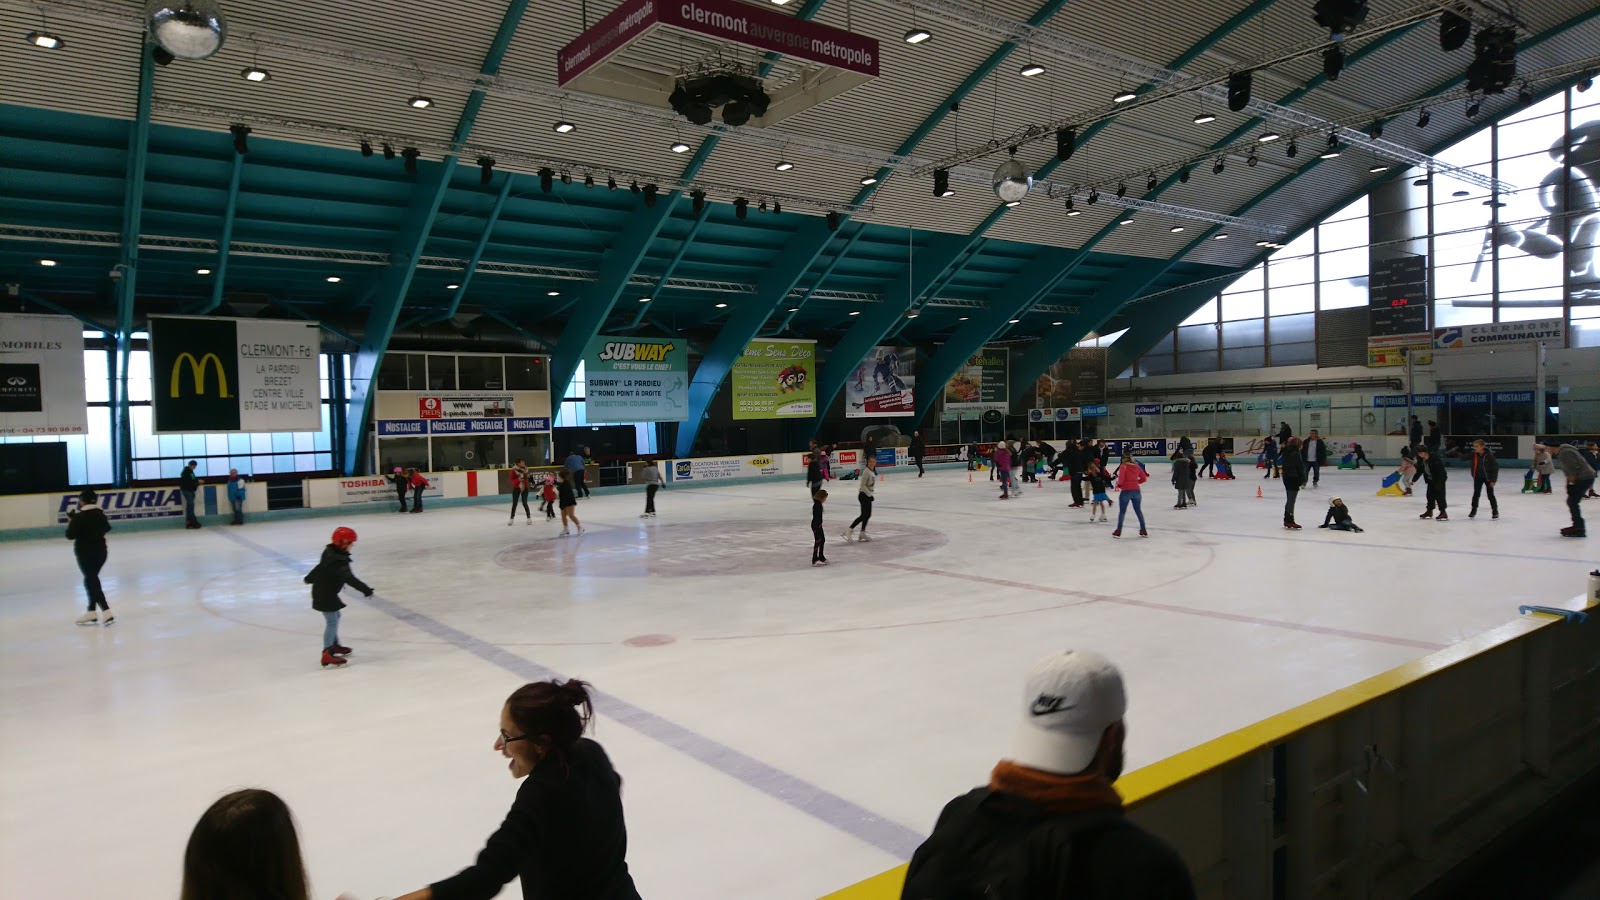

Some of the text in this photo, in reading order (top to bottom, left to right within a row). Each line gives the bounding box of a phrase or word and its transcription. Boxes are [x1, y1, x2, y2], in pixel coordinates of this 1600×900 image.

[564, 43, 591, 72] clermont
[618, 1, 653, 34] métropole
[681, 3, 872, 66] clermont auvergne métropole
[1471, 321, 1561, 334] CLERMONT
[1471, 329, 1561, 342] COMMUNAUTÉ
[598, 341, 675, 363] SUBWAY
[765, 344, 788, 357] Sens
[256, 364, 300, 374] LA PARDIEU
[264, 376, 293, 386] BREZET
[253, 388, 304, 398] CENTRE VILLE
[1496, 394, 1532, 402] NOSTALGIE
[427, 399, 434, 409] 4
[1376, 396, 1408, 406] NOSTALGIE
[1414, 395, 1446, 404] NOSTALGIE
[1454, 394, 1488, 404] NOSTALGIE
[244, 401, 268, 410] STADE
[385, 422, 422, 433] NOSTALGIE
[432, 421, 466, 431] NOSTALGIE
[471, 420, 504, 430] NOSTALGIE
[513, 420, 544, 429] NOSTALGIE
[1122, 441, 1159, 449] FLEURY
[341, 479, 386, 488] TOSHIBA
[58, 490, 183, 513] FTURIA
